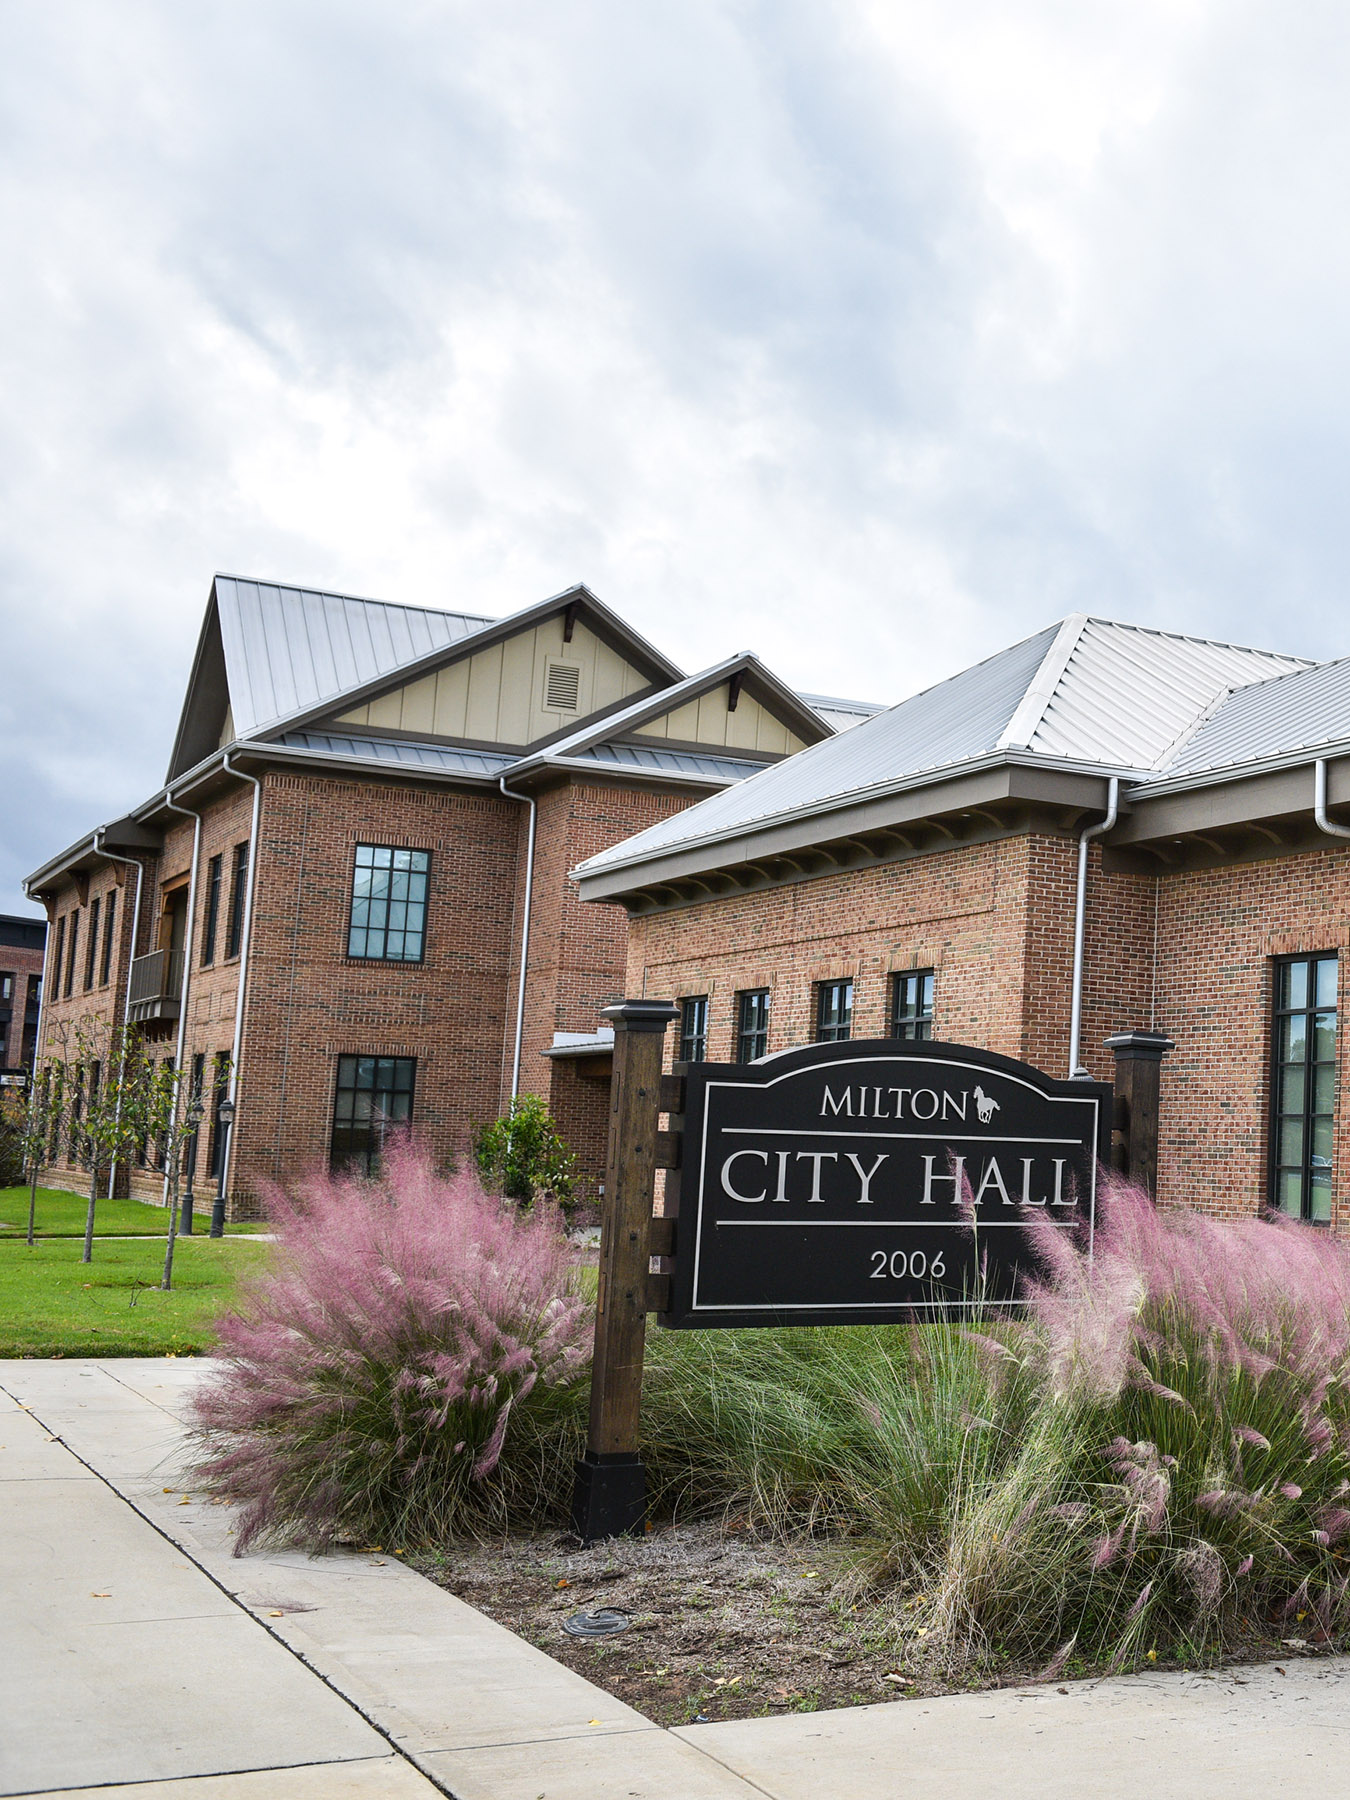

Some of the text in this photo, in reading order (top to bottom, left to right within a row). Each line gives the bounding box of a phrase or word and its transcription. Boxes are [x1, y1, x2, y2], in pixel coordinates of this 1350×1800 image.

[818, 1083, 969, 1121] MILTON
[719, 1149, 1080, 1206] CITY HALL
[869, 1249, 947, 1279] 2006
